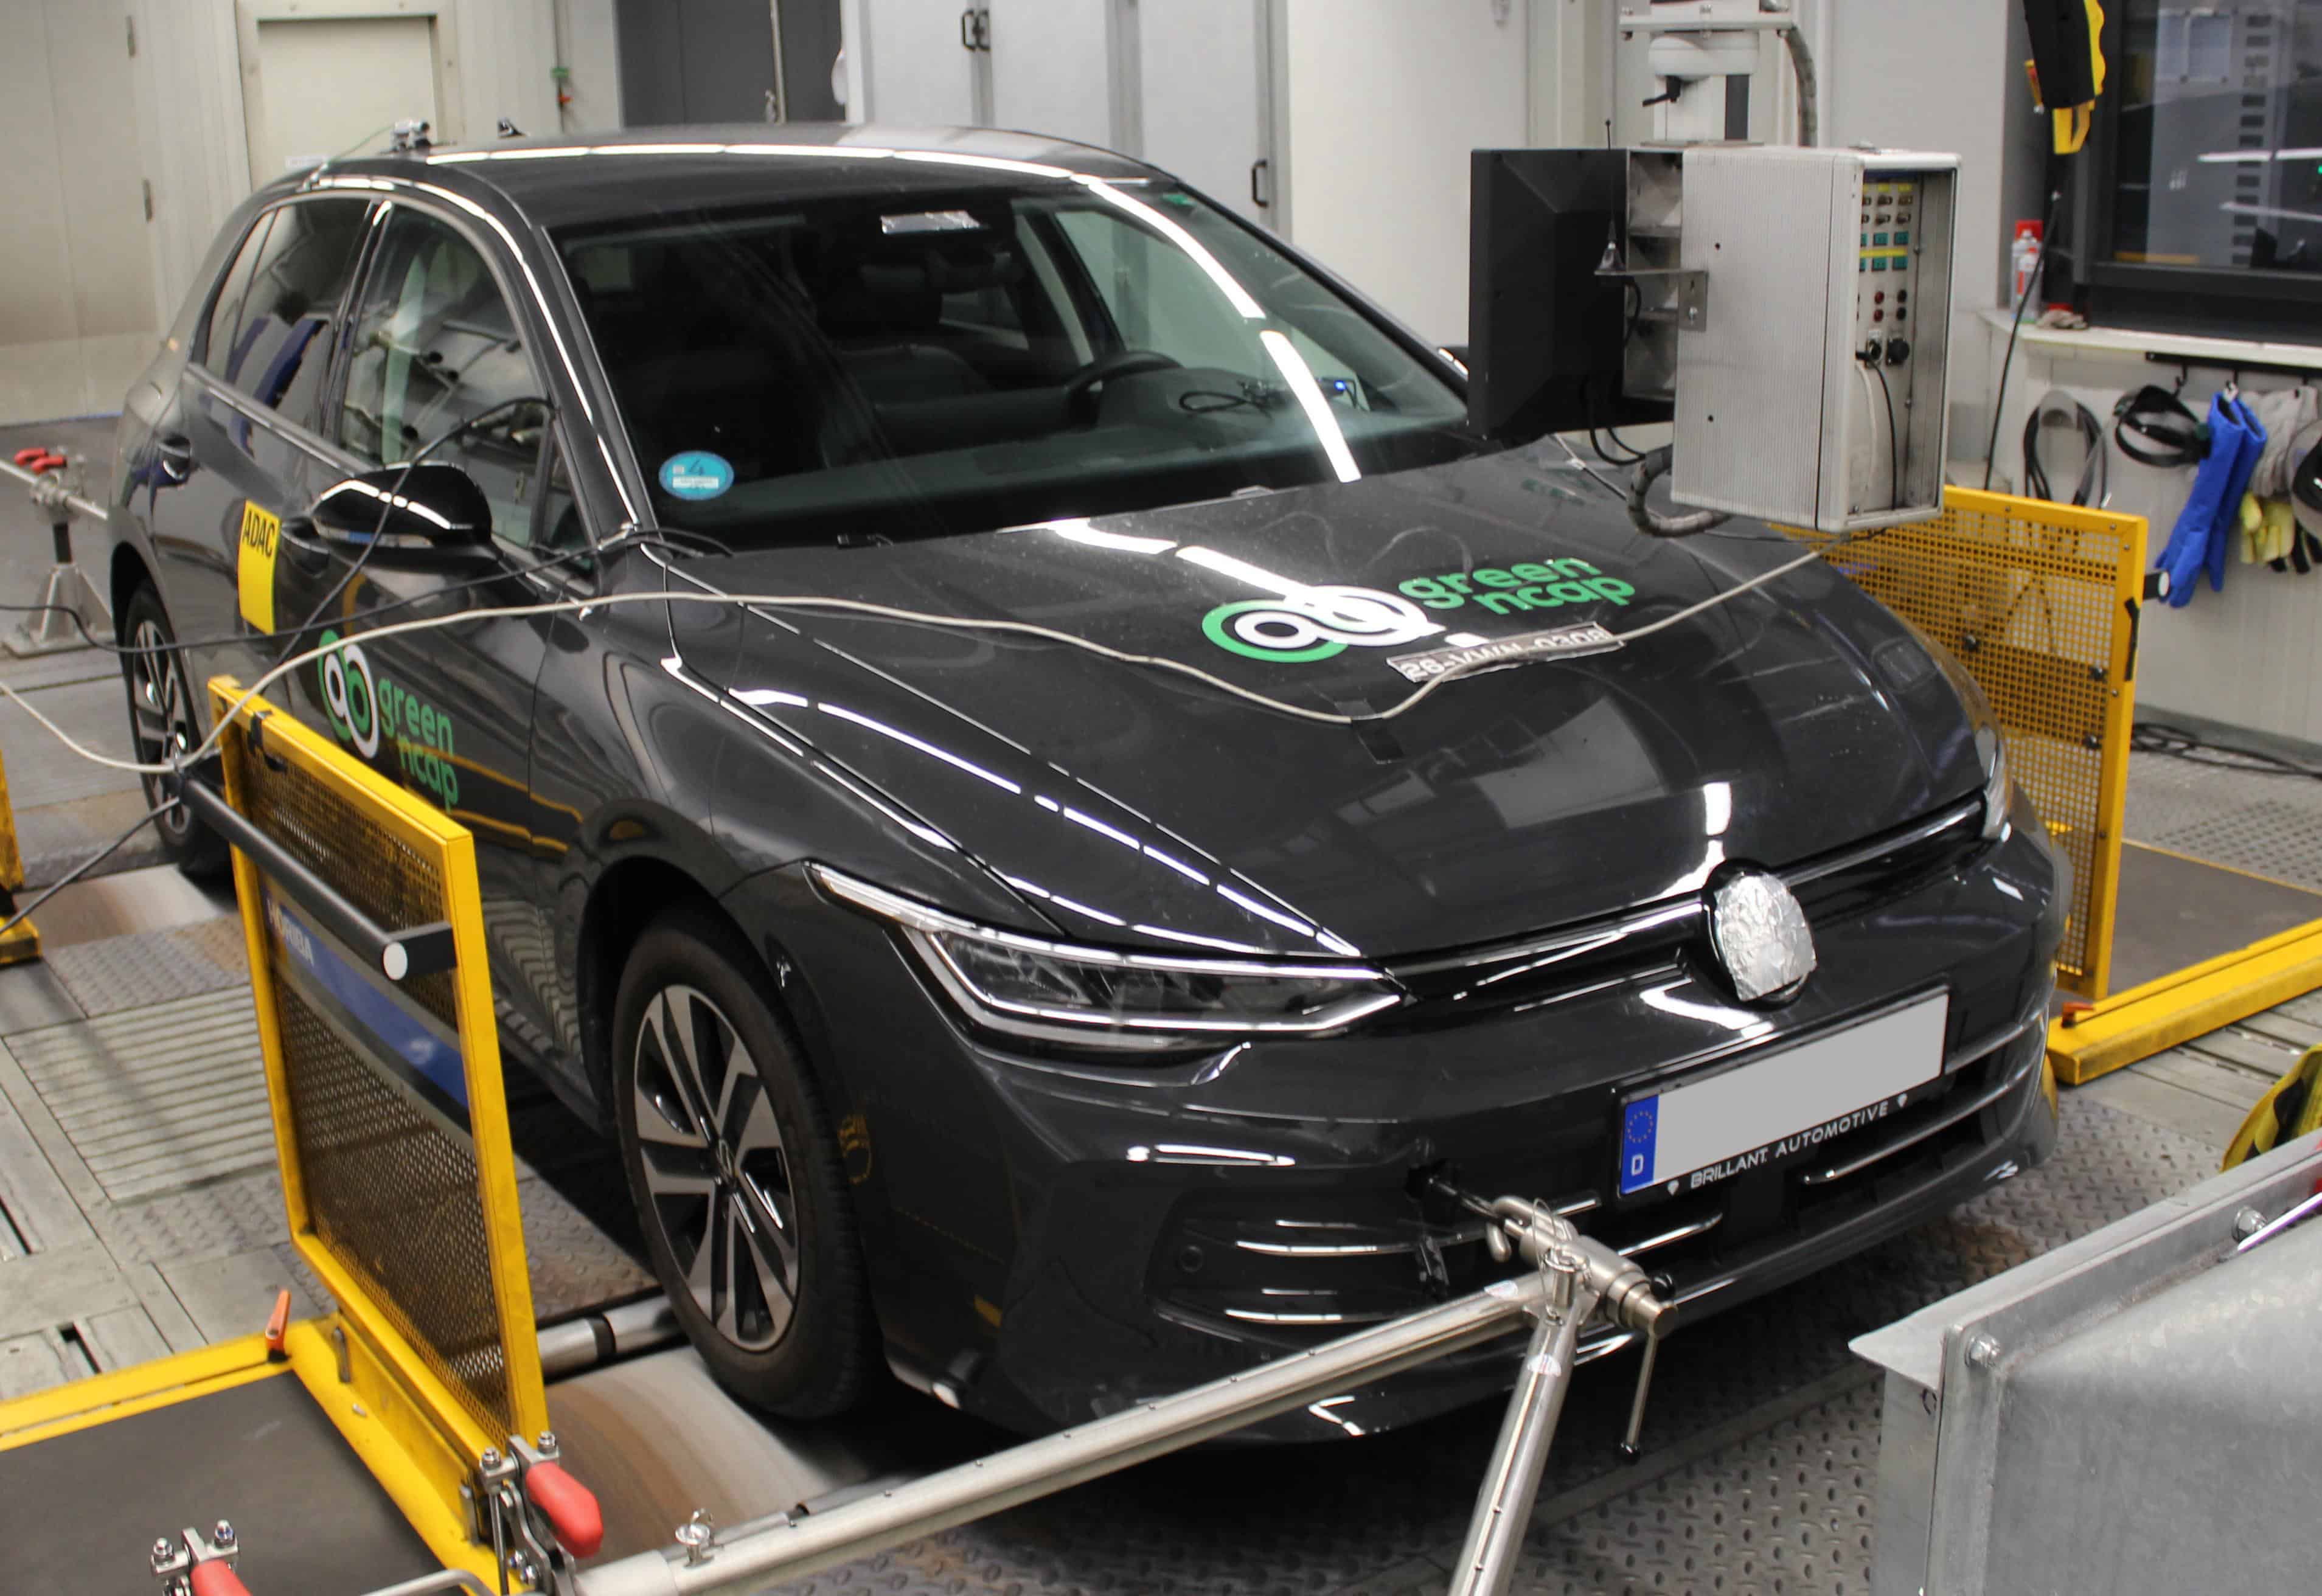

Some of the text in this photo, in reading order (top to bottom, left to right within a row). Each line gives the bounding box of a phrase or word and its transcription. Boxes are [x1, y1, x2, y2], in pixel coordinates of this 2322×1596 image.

[243, 510, 276, 558] ADAC
[1399, 558, 1602, 609] green
[1472, 577, 1636, 614] ncap
[378, 676, 454, 758] green
[397, 732, 459, 814] ncap
[1775, 1100, 1889, 1159] AUTOMOTIVE
[1631, 1153, 1644, 1176] D
